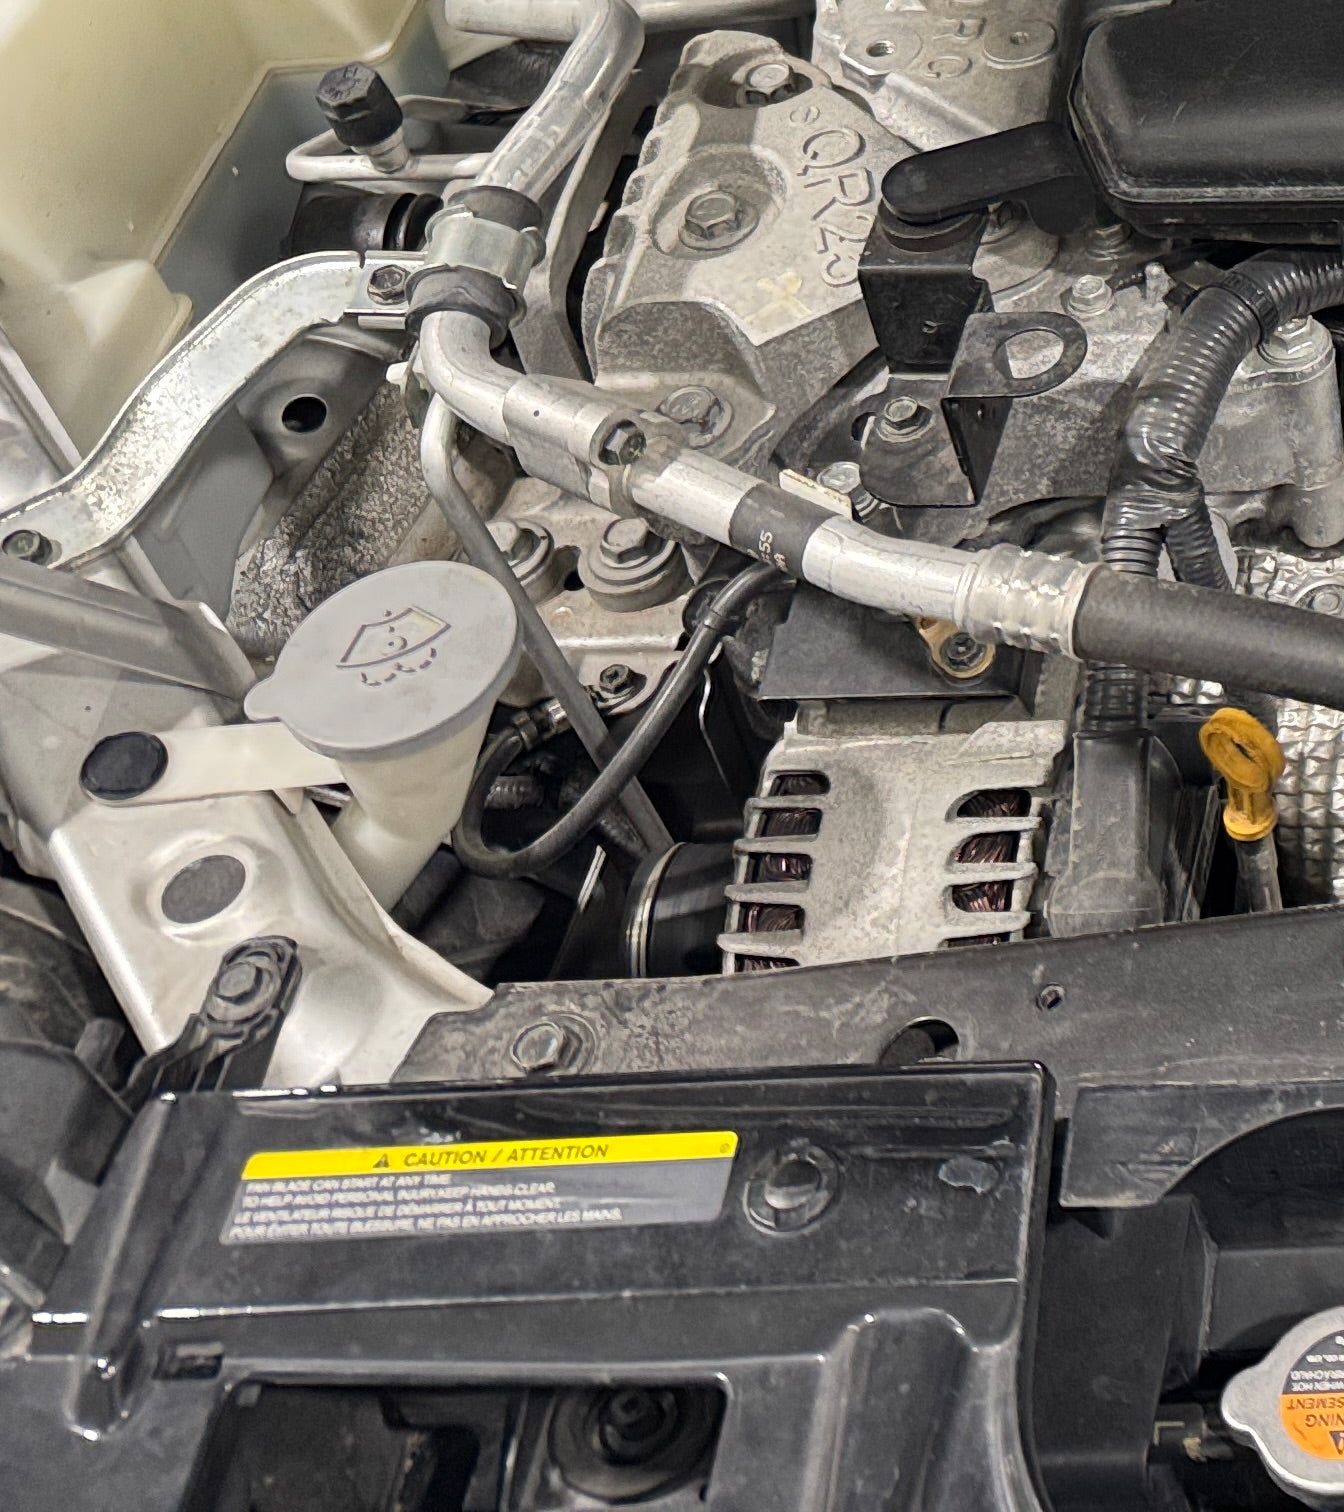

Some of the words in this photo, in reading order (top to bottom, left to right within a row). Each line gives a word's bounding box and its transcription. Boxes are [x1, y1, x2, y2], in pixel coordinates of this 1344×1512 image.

[403, 1150, 488, 1167] CAUTION
[491, 1148, 503, 1163] /
[507, 1144, 610, 1163] ATTENTION
[242, 1194, 260, 1209] TO
[259, 1193, 293, 1208] HELP
[293, 1192, 332, 1207] AVOID
[331, 1188, 395, 1204] PERSONAL
[470, 1183, 513, 1197] HANDS
[245, 1182, 271, 1194] FAN
[271, 1179, 312, 1193] BLADE
[312, 1178, 340, 1192] CAN
[341, 1176, 378, 1191] START
[378, 1175, 395, 1189] AT
[395, 1174, 422, 1188] ANY
[233, 1213, 252, 1226] LE
[252, 1207, 330, 1224] VENTILATEUR
[331, 1206, 377, 1221] RISQUE
[377, 1205, 395, 1219] DE
[475, 1198, 507, 1213] TOUT
[228, 1224, 267, 1241] POUR
[309, 1221, 349, 1237] TOUTE
[416, 1216, 435, 1230] NE
[435, 1214, 462, 1229] PAS
[462, 1213, 480, 1228] EN
[480, 1210, 557, 1227] APPROCHER
[557, 1209, 581, 1224] LES
[1314, 1380, 1344, 1391] WHEN
